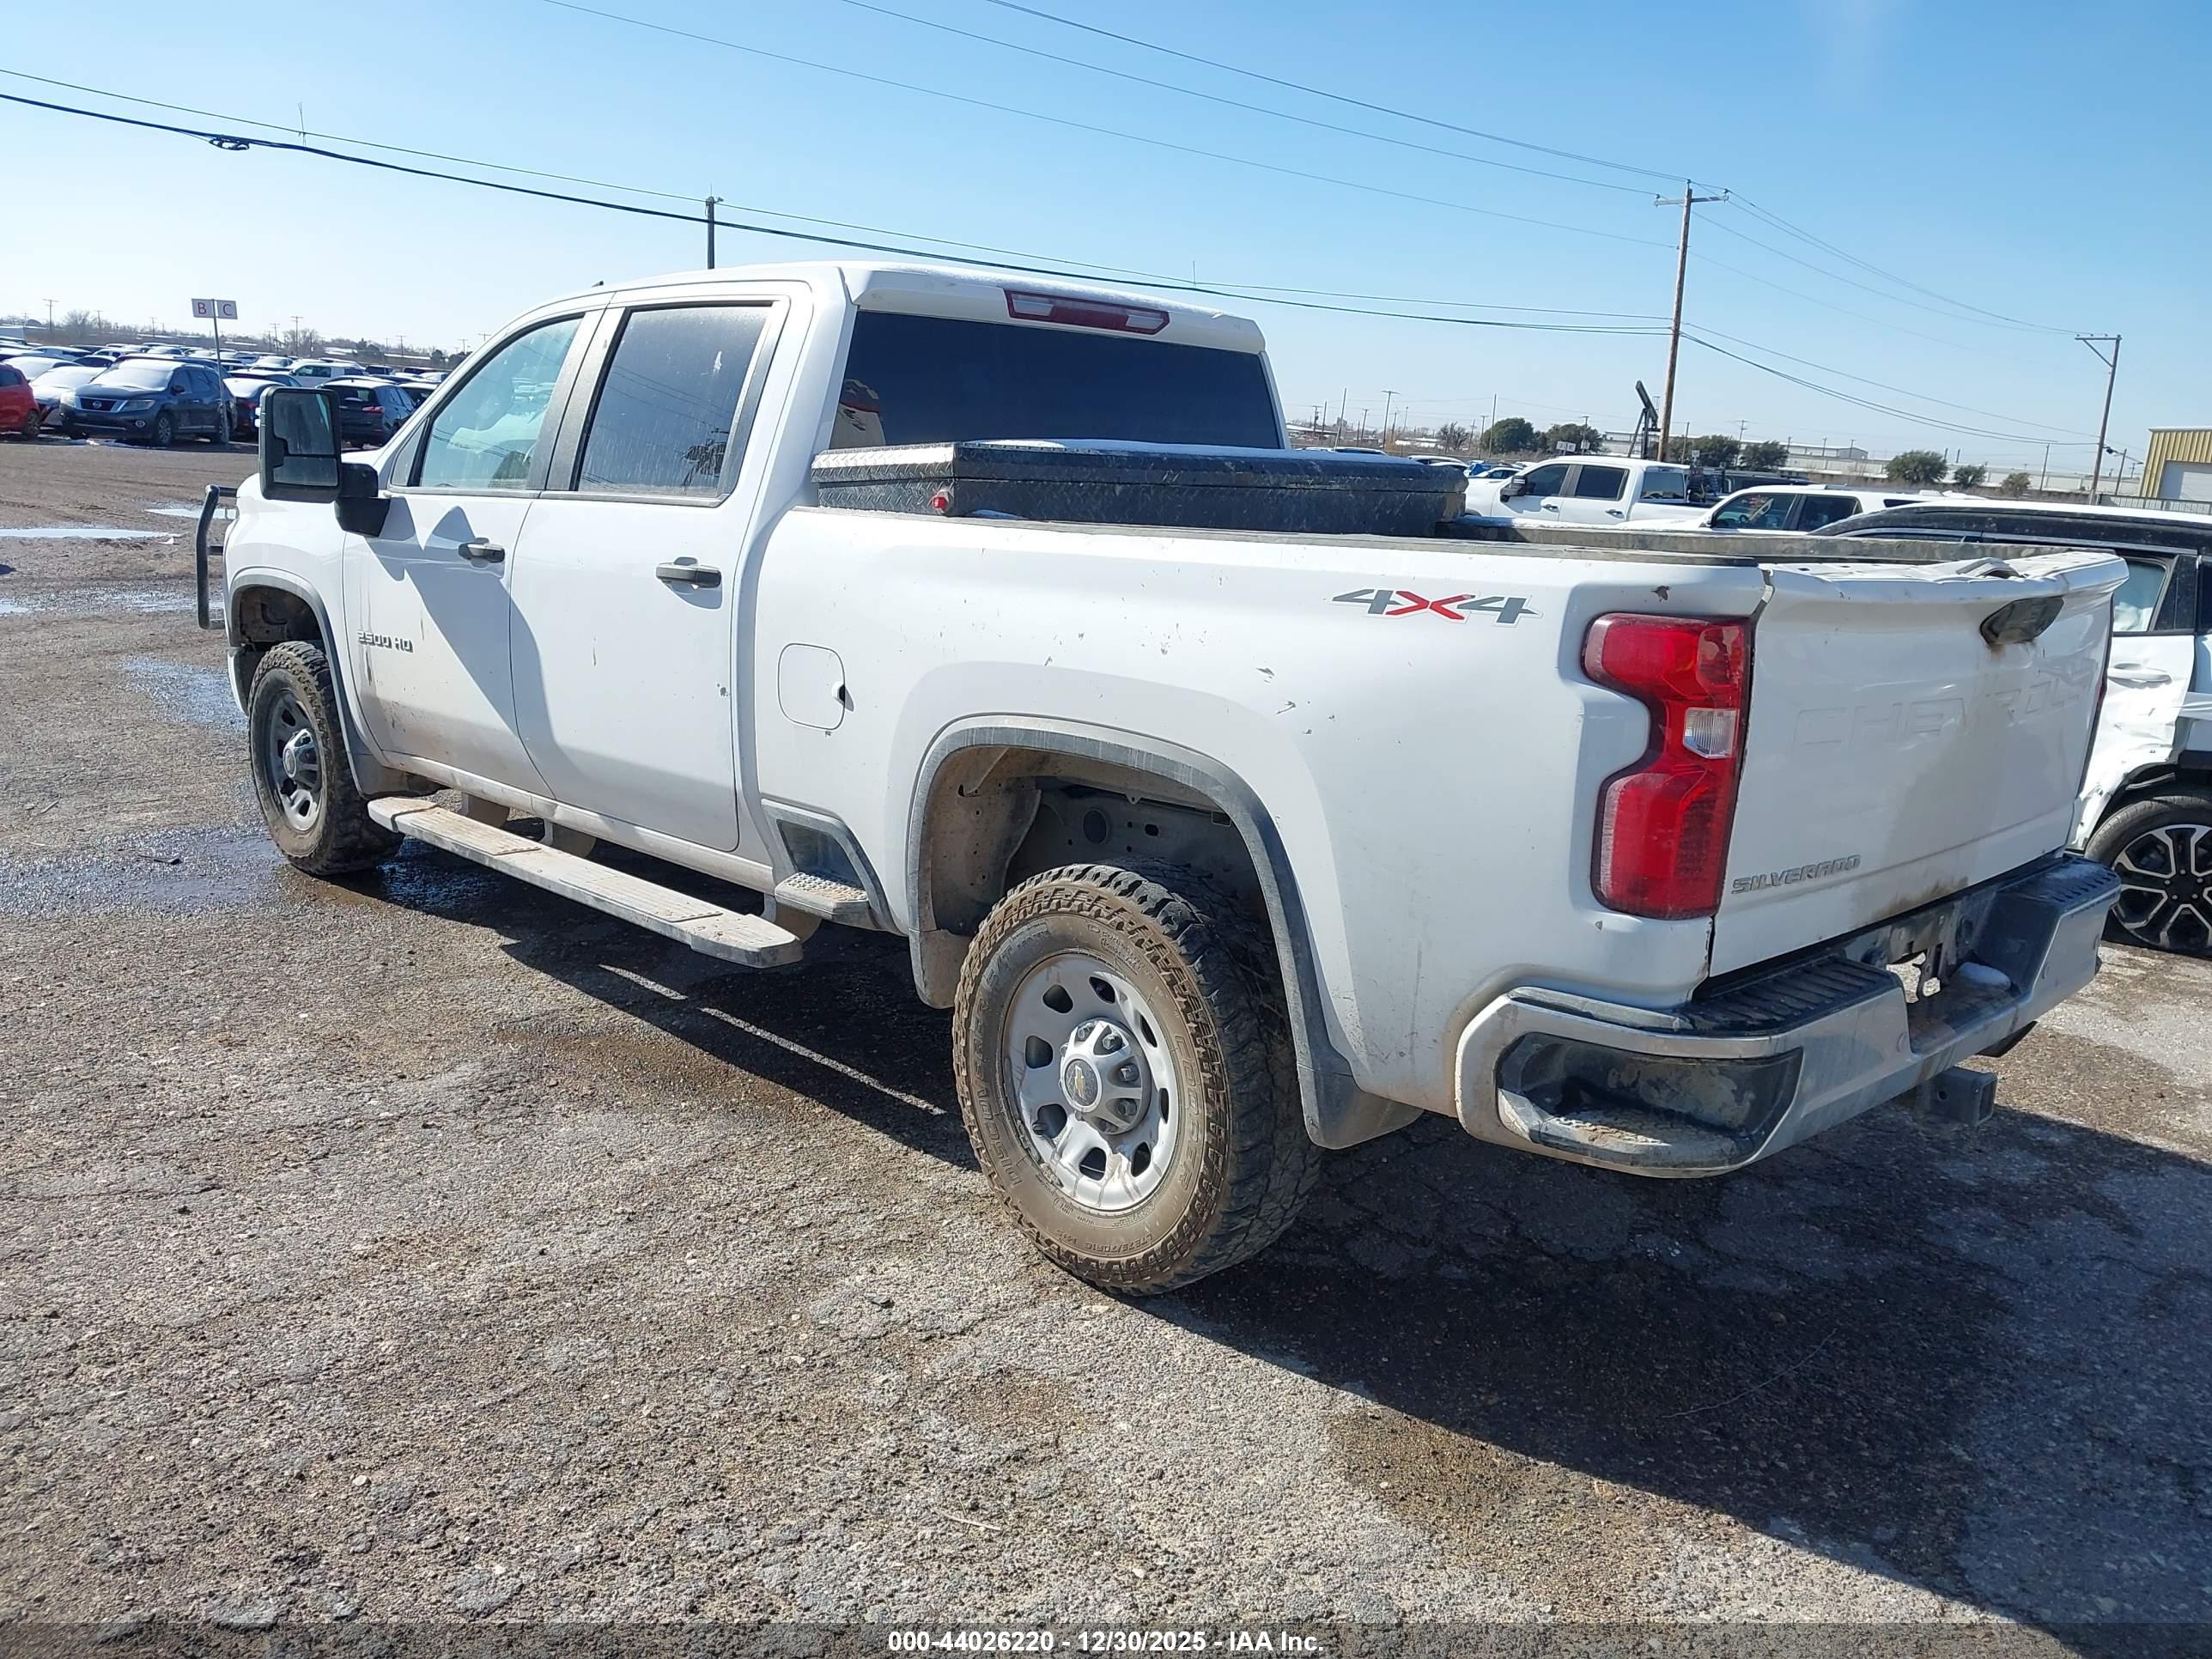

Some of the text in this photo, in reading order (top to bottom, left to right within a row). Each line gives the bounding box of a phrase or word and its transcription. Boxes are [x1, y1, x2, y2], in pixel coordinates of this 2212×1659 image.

[198, 301, 207, 314] B
[222, 303, 233, 316] C
[357, 630, 414, 653] 2500 HD
[1731, 854, 1862, 894] SILVERADO
[1174, 1035, 1200, 1190] COOPER
